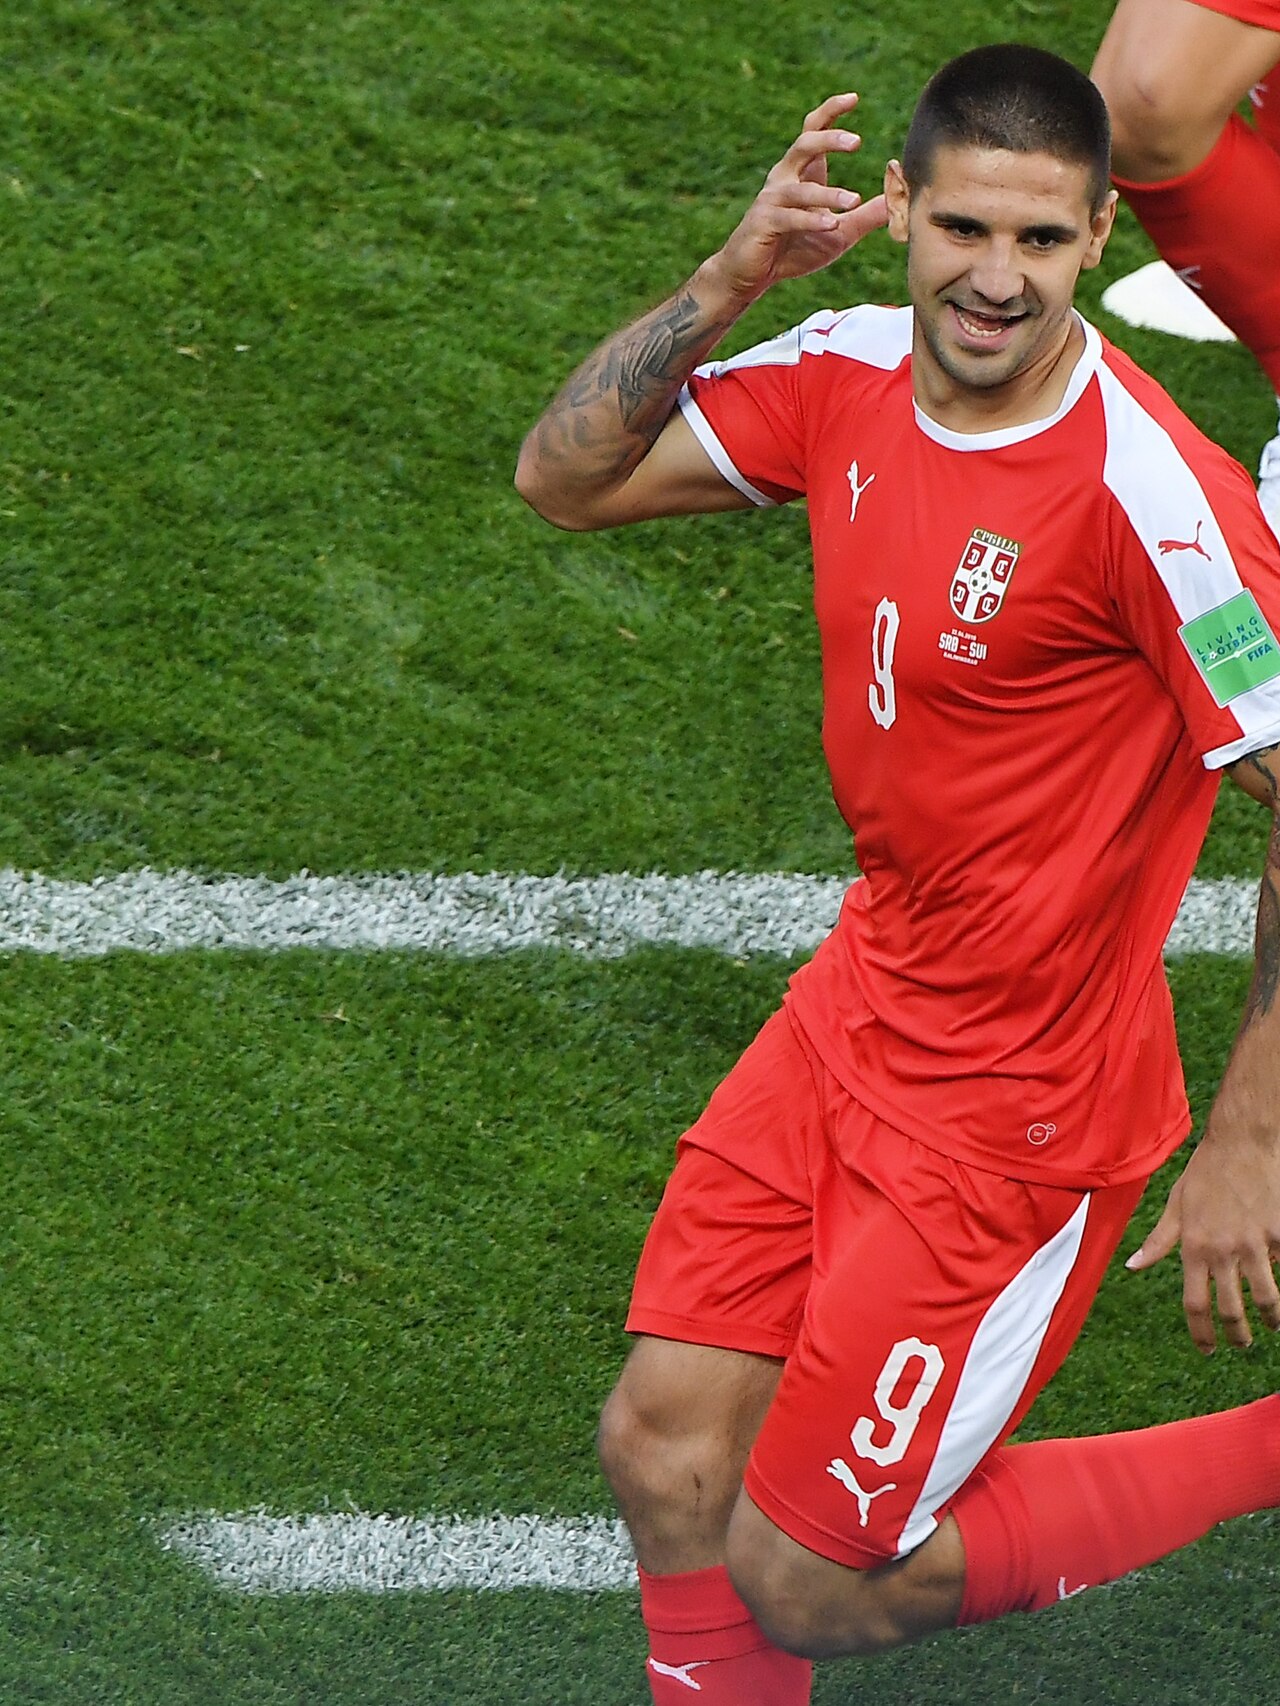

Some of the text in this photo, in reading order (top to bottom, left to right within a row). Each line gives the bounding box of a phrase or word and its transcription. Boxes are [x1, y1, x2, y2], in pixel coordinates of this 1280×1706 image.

[938, 632, 959, 653] SRB
[969, 641, 988, 660] SUI
[1196, 616, 1258, 656] LIVING
[1247, 643, 1273, 662] FIFA
[868, 596, 900, 730] 9
[850, 1336, 945, 1467] 9
